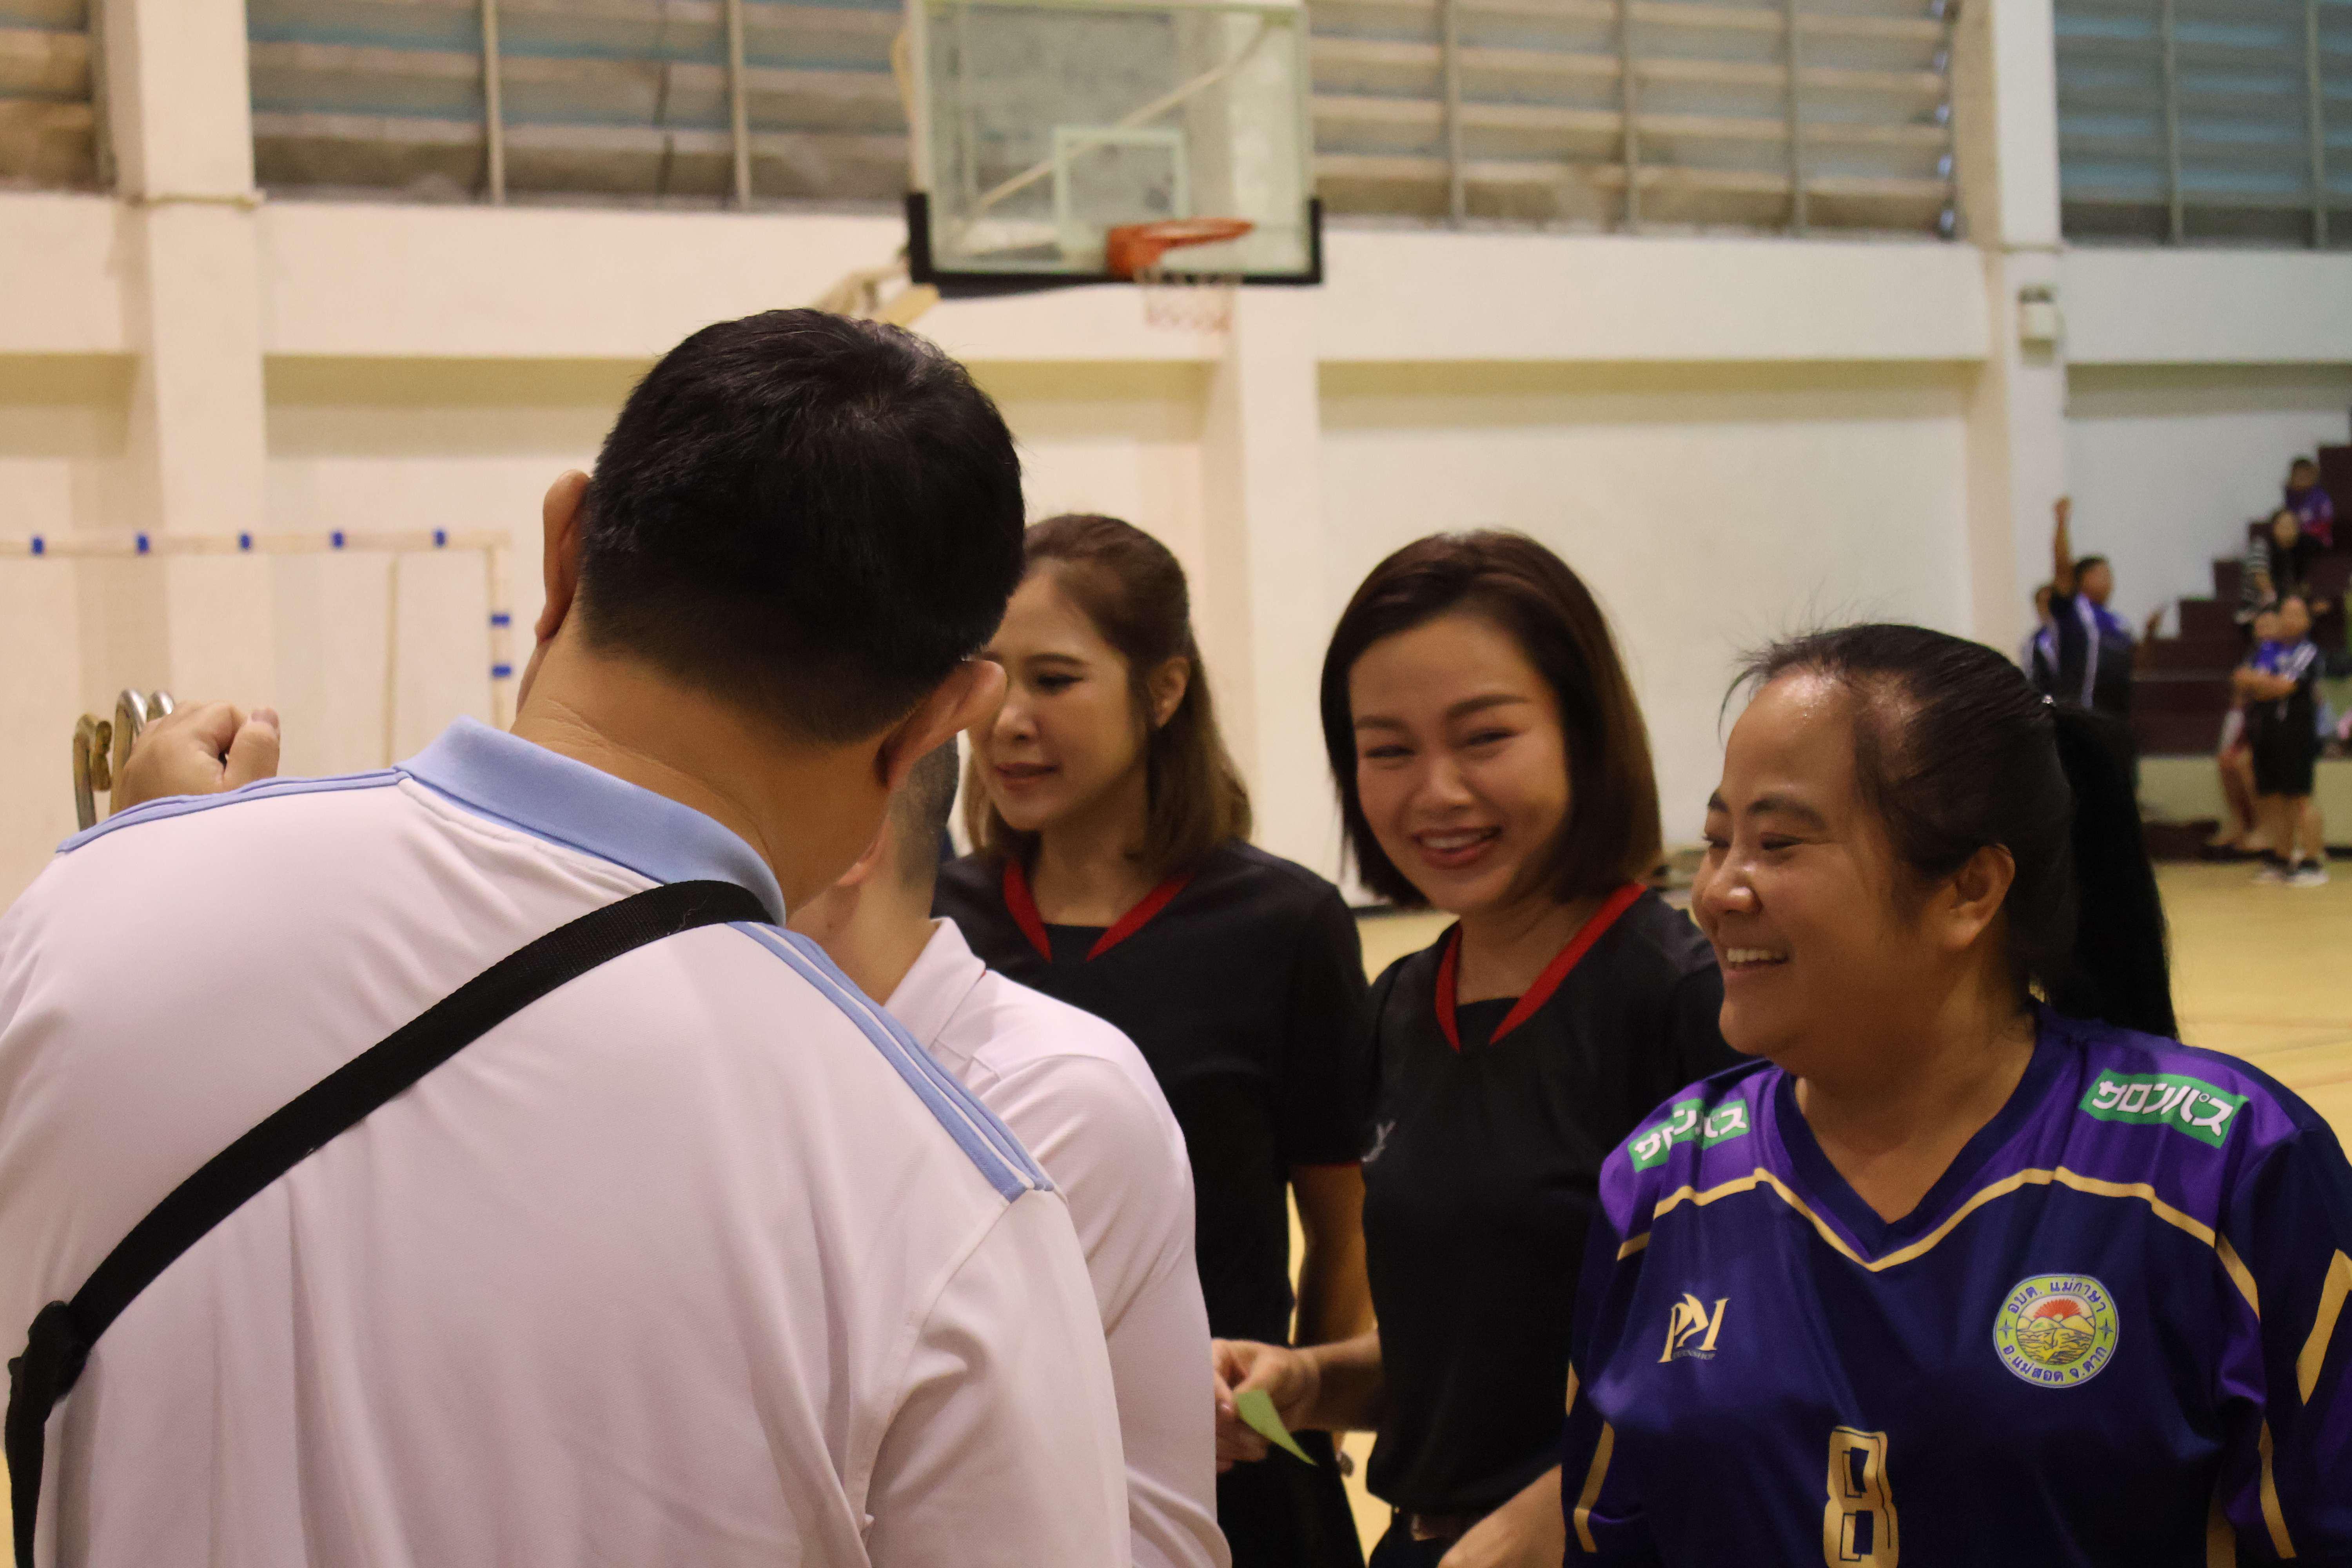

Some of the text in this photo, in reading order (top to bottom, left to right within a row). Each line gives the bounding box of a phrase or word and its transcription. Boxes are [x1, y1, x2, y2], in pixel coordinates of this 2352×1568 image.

[2092, 1080, 2234, 1136] サロンパス
[1823, 1425, 1900, 1568] 8
